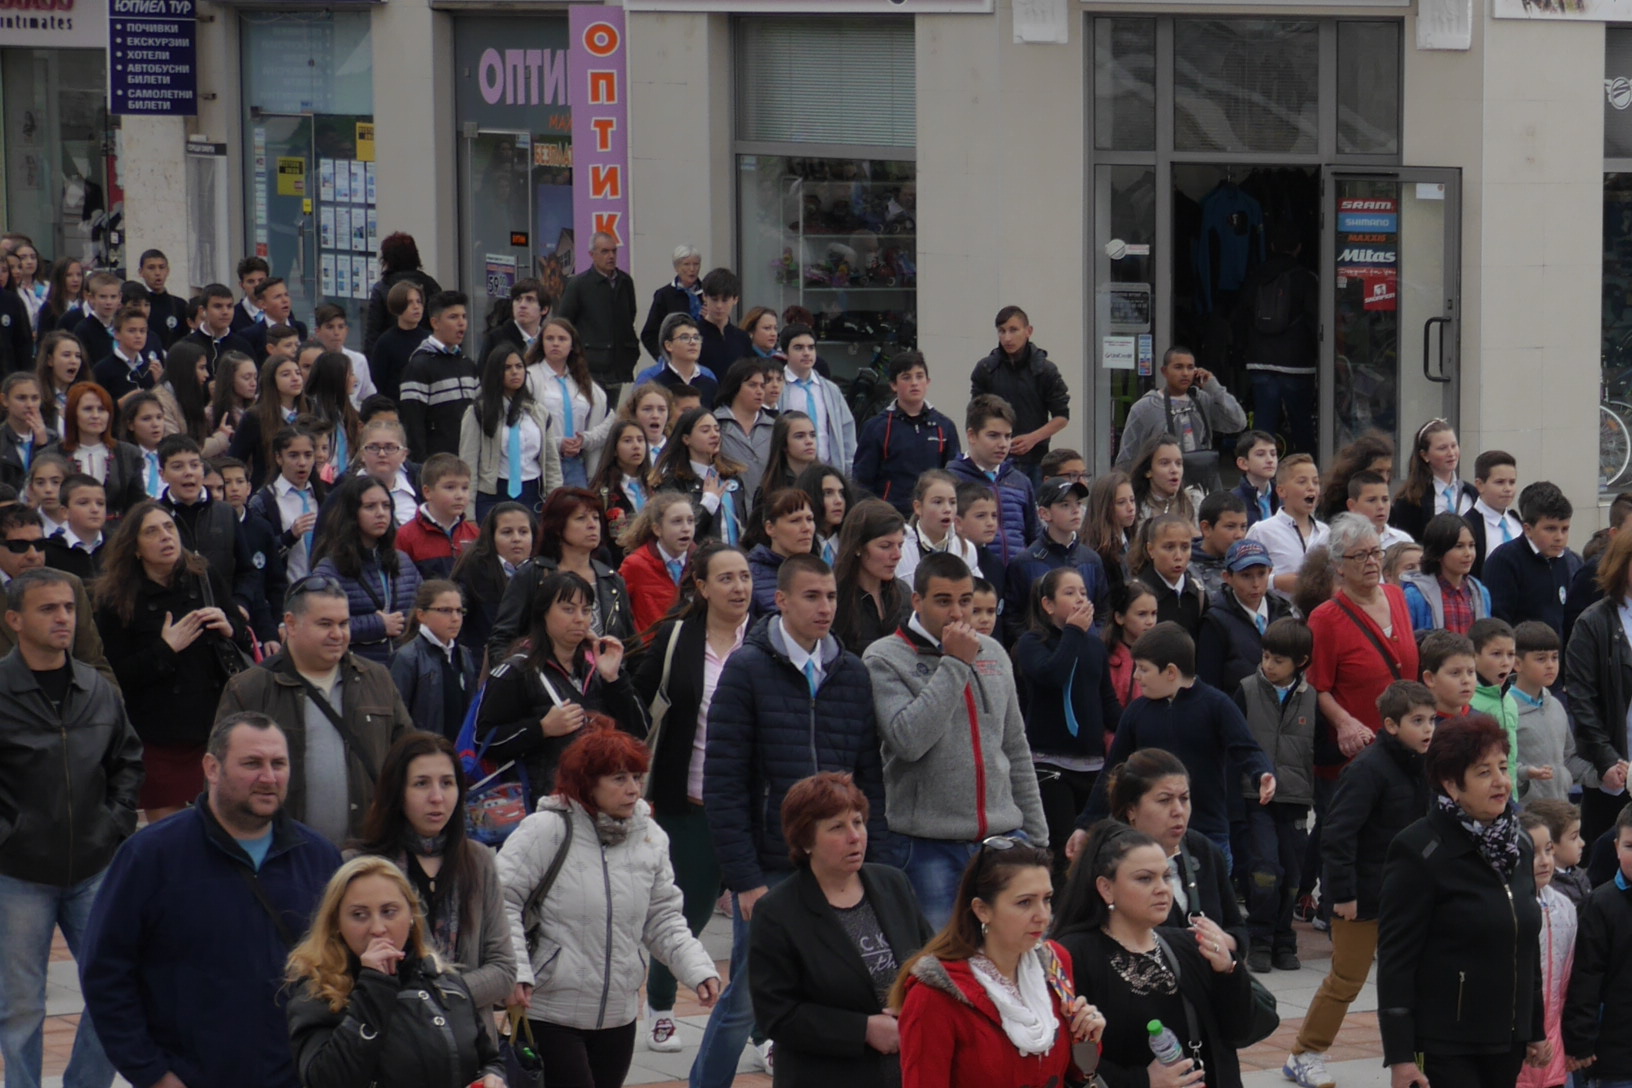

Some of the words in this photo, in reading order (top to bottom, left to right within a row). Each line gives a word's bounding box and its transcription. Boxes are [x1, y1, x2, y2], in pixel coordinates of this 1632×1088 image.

[115, 0, 166, 14] ЮПИЕЛ
[169, 1, 192, 15] ТУР
[126, 23, 178, 34] ПОЧИВКИ
[126, 37, 190, 48] ЕКСКУРЗИИ
[127, 51, 170, 61] ХОТЕЛИ
[127, 64, 190, 74] АВТОБУСНИ
[128, 75, 170, 85] БИЛЕТИ
[478, 47, 573, 106] ОПТИ
[128, 89, 192, 100] САМОЛЕТНИ
[128, 100, 171, 111] БИЛЕТИ
[1341, 201, 1392, 210] SRAM
[1348, 234, 1386, 242] MAXXIS
[1337, 248, 1396, 262] Mitas
